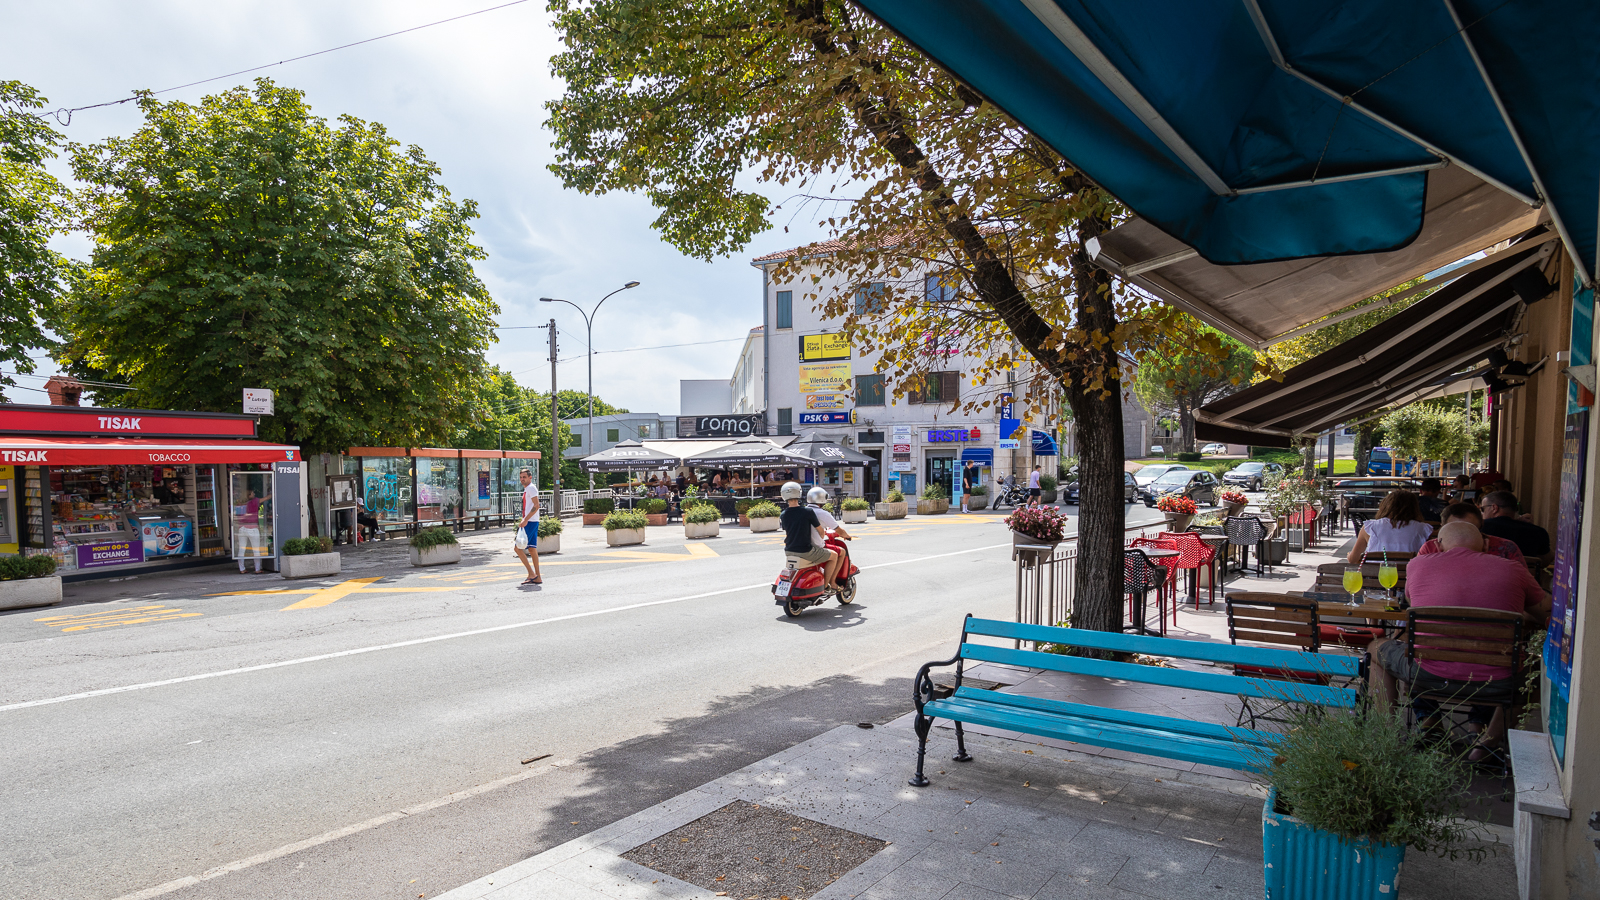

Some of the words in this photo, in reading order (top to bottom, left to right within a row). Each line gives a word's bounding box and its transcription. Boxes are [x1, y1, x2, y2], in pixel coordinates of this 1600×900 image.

[98, 416, 142, 430] TISAK
[803, 414, 823, 423] PSK
[701, 417, 750, 433] roma
[927, 429, 969, 442] ERSTE
[1, 450, 48, 462] TISAK
[148, 453, 191, 462] TOBACCO
[610, 450, 651, 458] jana
[92, 550, 130, 560] EXCHANGE
